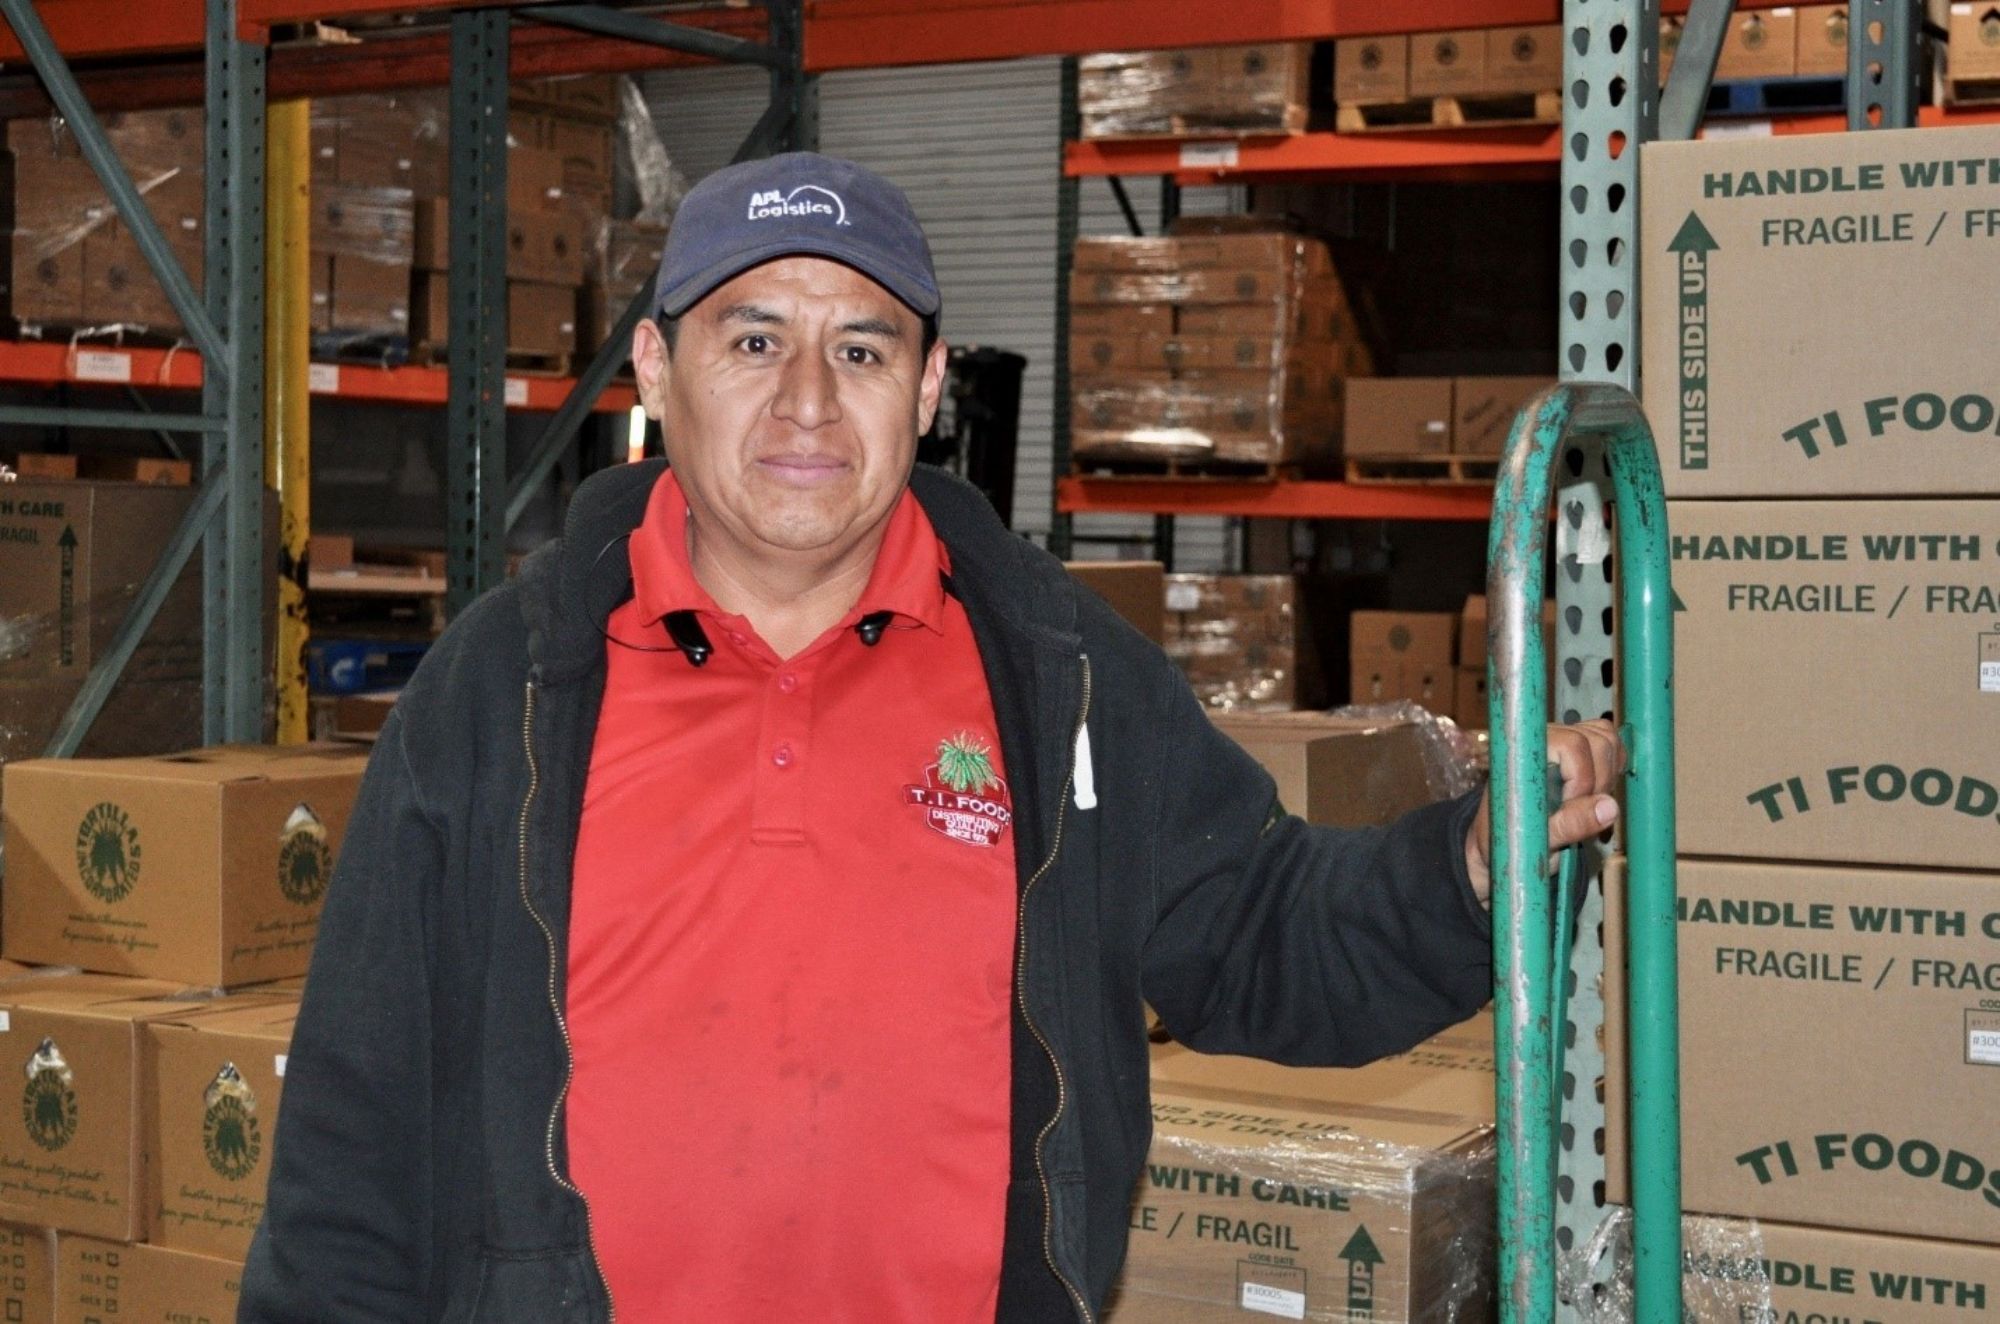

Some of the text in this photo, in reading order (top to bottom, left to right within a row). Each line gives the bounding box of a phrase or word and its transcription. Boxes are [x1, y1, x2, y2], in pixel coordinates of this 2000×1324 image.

[750, 189, 786, 207] APL
[1703, 164, 1885, 199] HANDLE
[748, 200, 833, 220] Logistics
[1761, 213, 1914, 247] FRAGILE
[1924, 210, 1948, 246] /
[1683, 250, 1706, 466] THIS SIDE UP
[1782, 392, 2000, 460] TI FOO
[18, 500, 65, 518] CARE
[1671, 535, 1848, 561] HANDLE
[1862, 534, 1980, 561] WITH
[1727, 584, 2000, 619] FRAGILE / FRA
[1746, 763, 2000, 826] TI FOOD
[1848, 905, 1966, 938] WITH
[1715, 947, 1863, 983] FRAGILE
[1873, 957, 1895, 991] /
[1199, 1109, 1289, 1127] SIDE
[1296, 1120, 1351, 1132] UP
[1735, 1140, 1800, 1185] TI
[1149, 1164, 1350, 1213] WITH CARE
[1196, 1214, 1300, 1251] FRAGIL
[1352, 1261, 1371, 1300] UP
[1869, 1271, 1986, 1310] WITH
